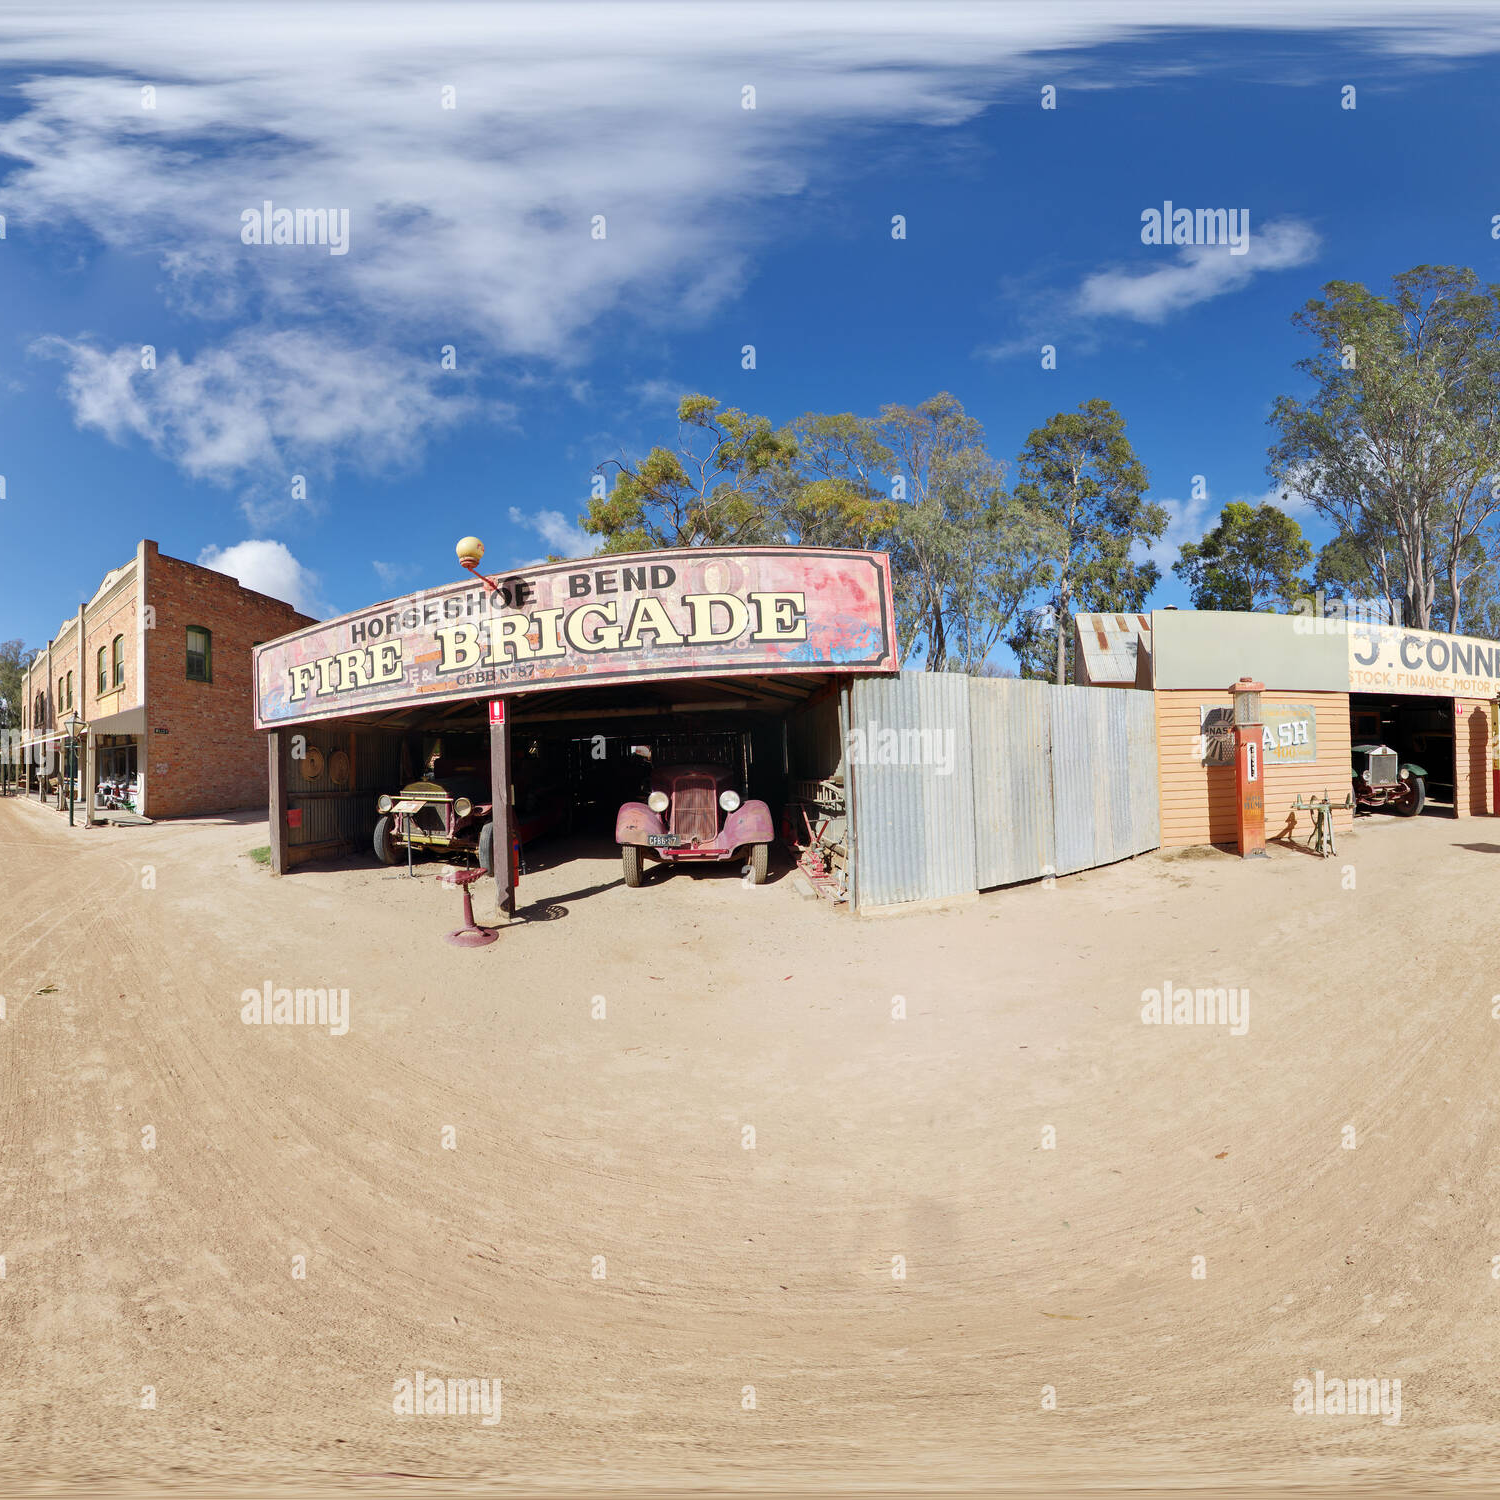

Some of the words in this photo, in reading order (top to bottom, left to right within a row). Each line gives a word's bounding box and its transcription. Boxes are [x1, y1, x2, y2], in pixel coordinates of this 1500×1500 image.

[351, 578, 538, 645] HORSESHOE
[568, 565, 677, 598] BEND
[288, 637, 404, 703] FIRE
[434, 591, 808, 676] BRIGADE
[517, 664, 535, 678] 87
[1453, 678, 1491, 693] MOTOR
[1273, 745, 1296, 759] 400
